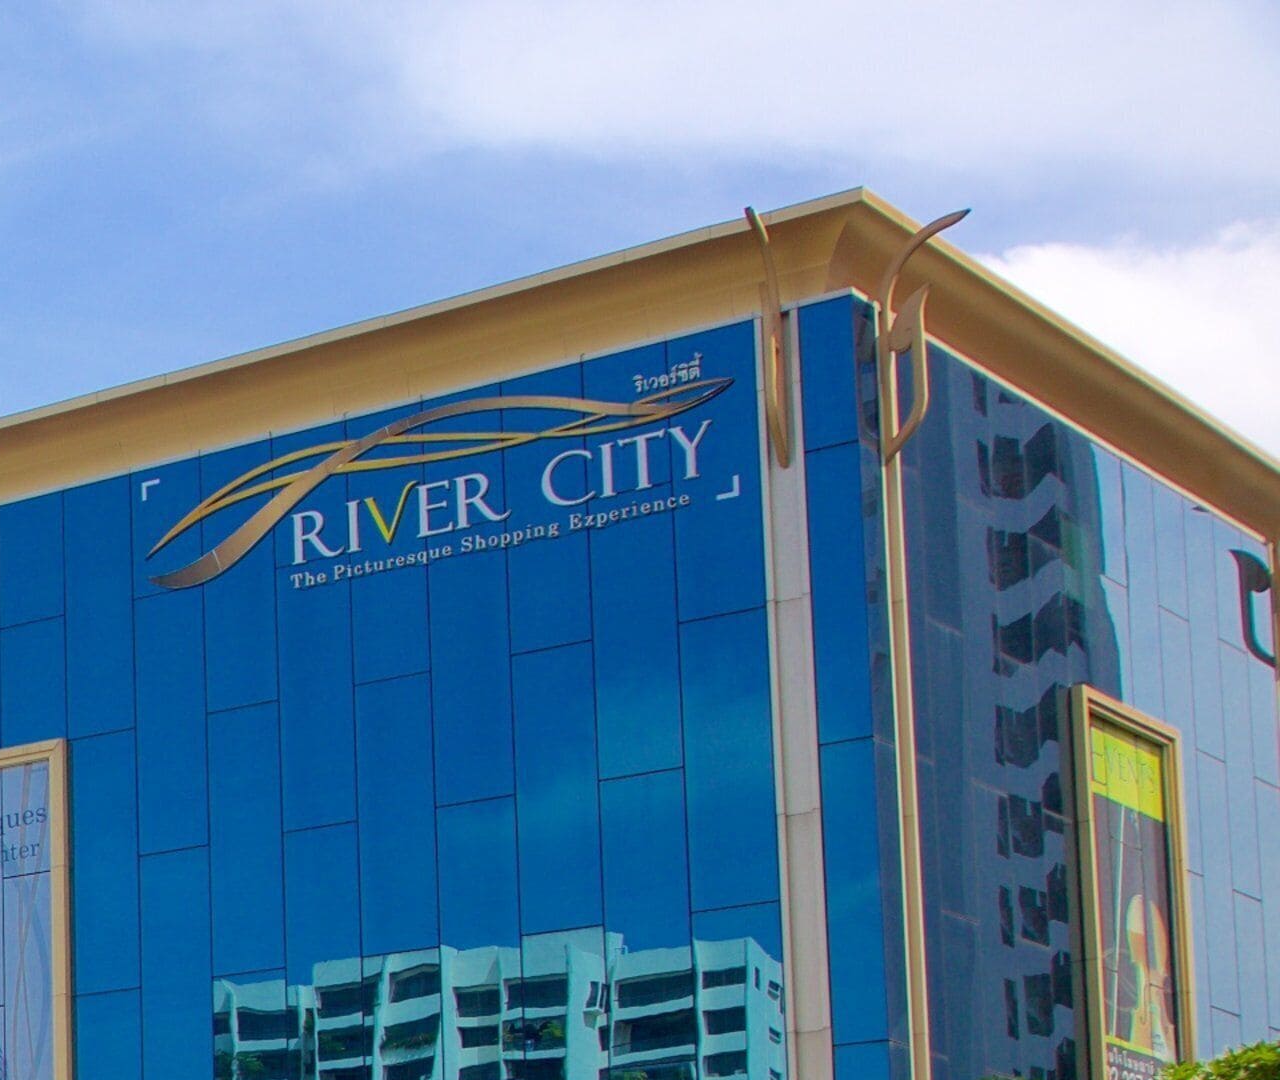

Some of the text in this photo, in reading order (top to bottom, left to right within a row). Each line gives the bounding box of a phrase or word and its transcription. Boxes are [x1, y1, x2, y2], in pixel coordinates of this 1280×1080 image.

[290, 493, 692, 589] The Picturesque Shopping Experience
[291, 418, 713, 566] RIVER CITY
